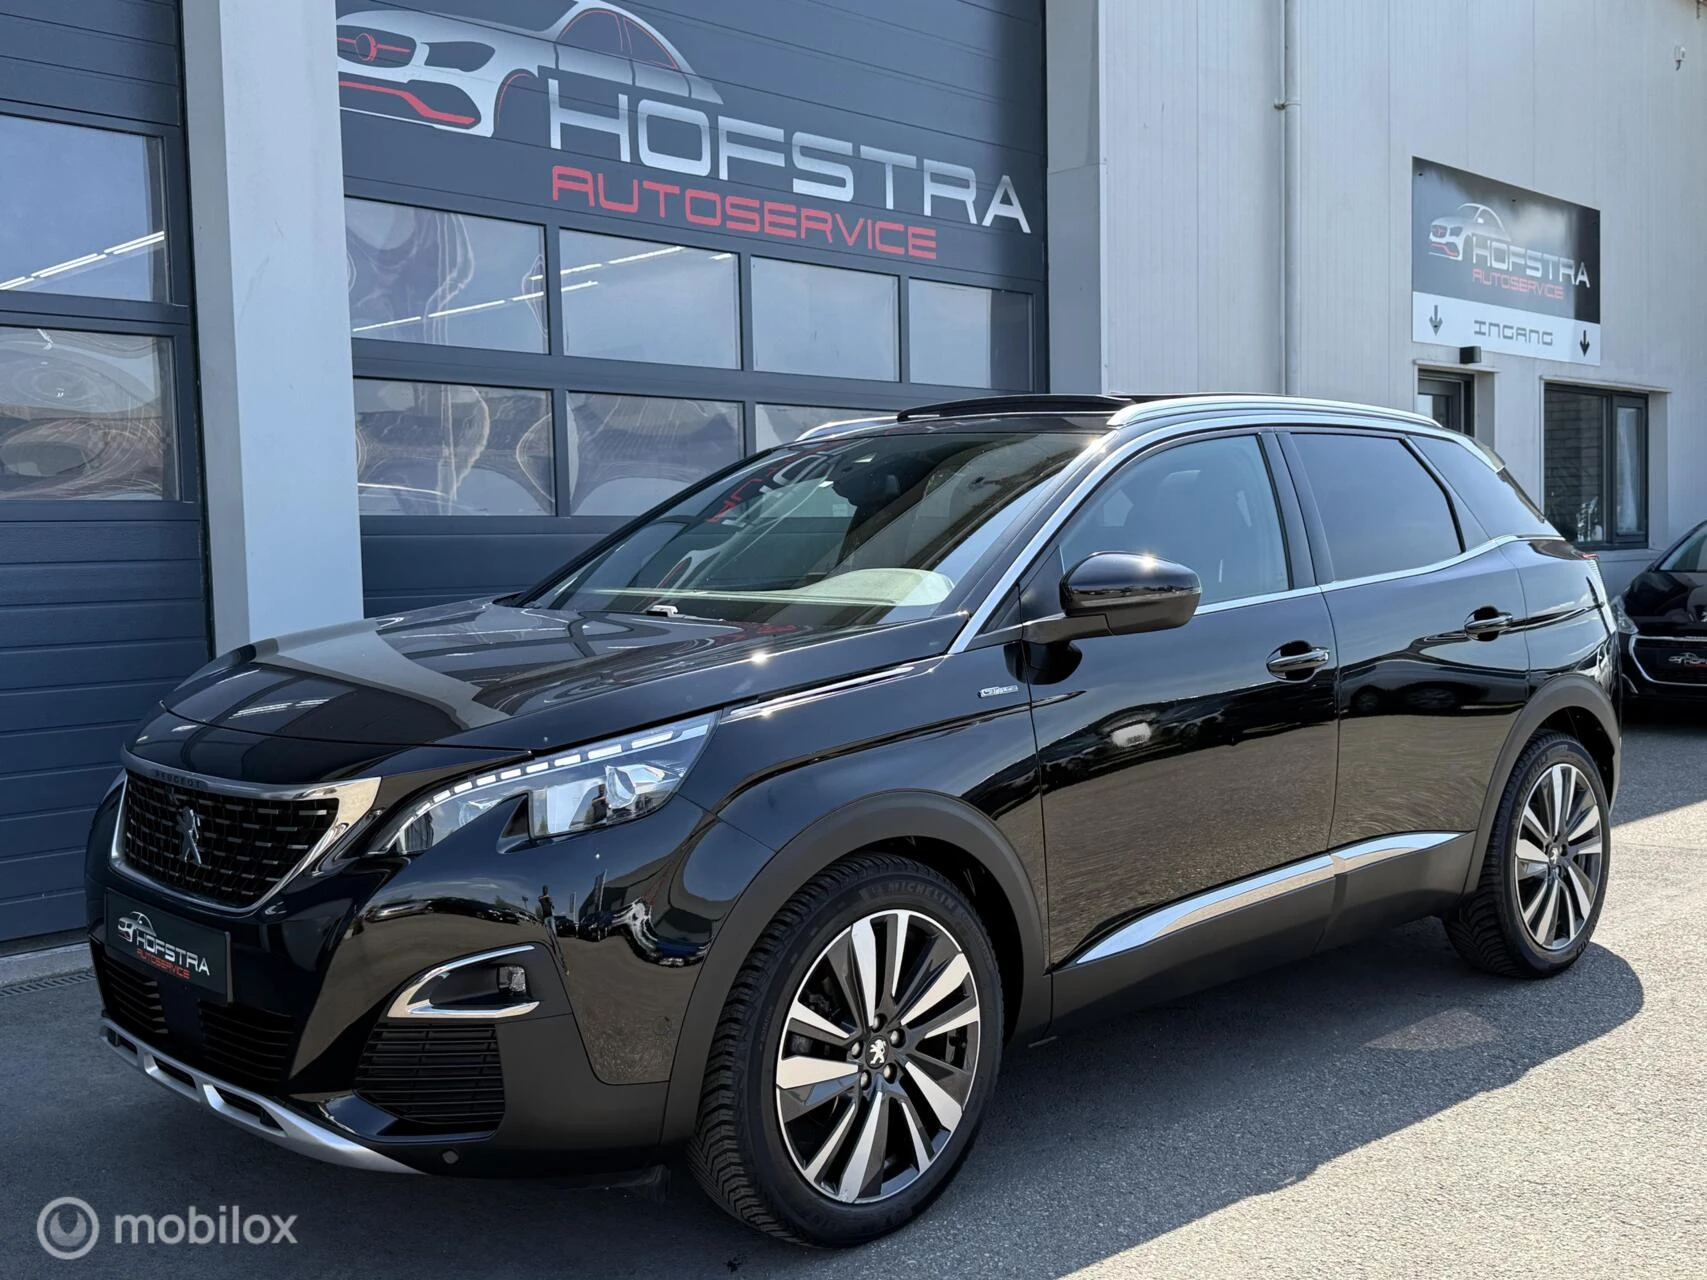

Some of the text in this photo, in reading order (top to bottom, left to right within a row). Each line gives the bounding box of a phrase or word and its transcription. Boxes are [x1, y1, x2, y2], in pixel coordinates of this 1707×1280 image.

[548, 78, 1031, 234] HOFSTRA
[551, 165, 937, 260] AUTOSERVICE
[1472, 268, 1564, 299] AUTOSERVICE
[1473, 236, 1590, 288] HOFSTRA
[1474, 320, 1553, 346] INGANG
[136, 929, 210, 976] HOFSTRA
[136, 951, 191, 980] AUTOSERVICE
